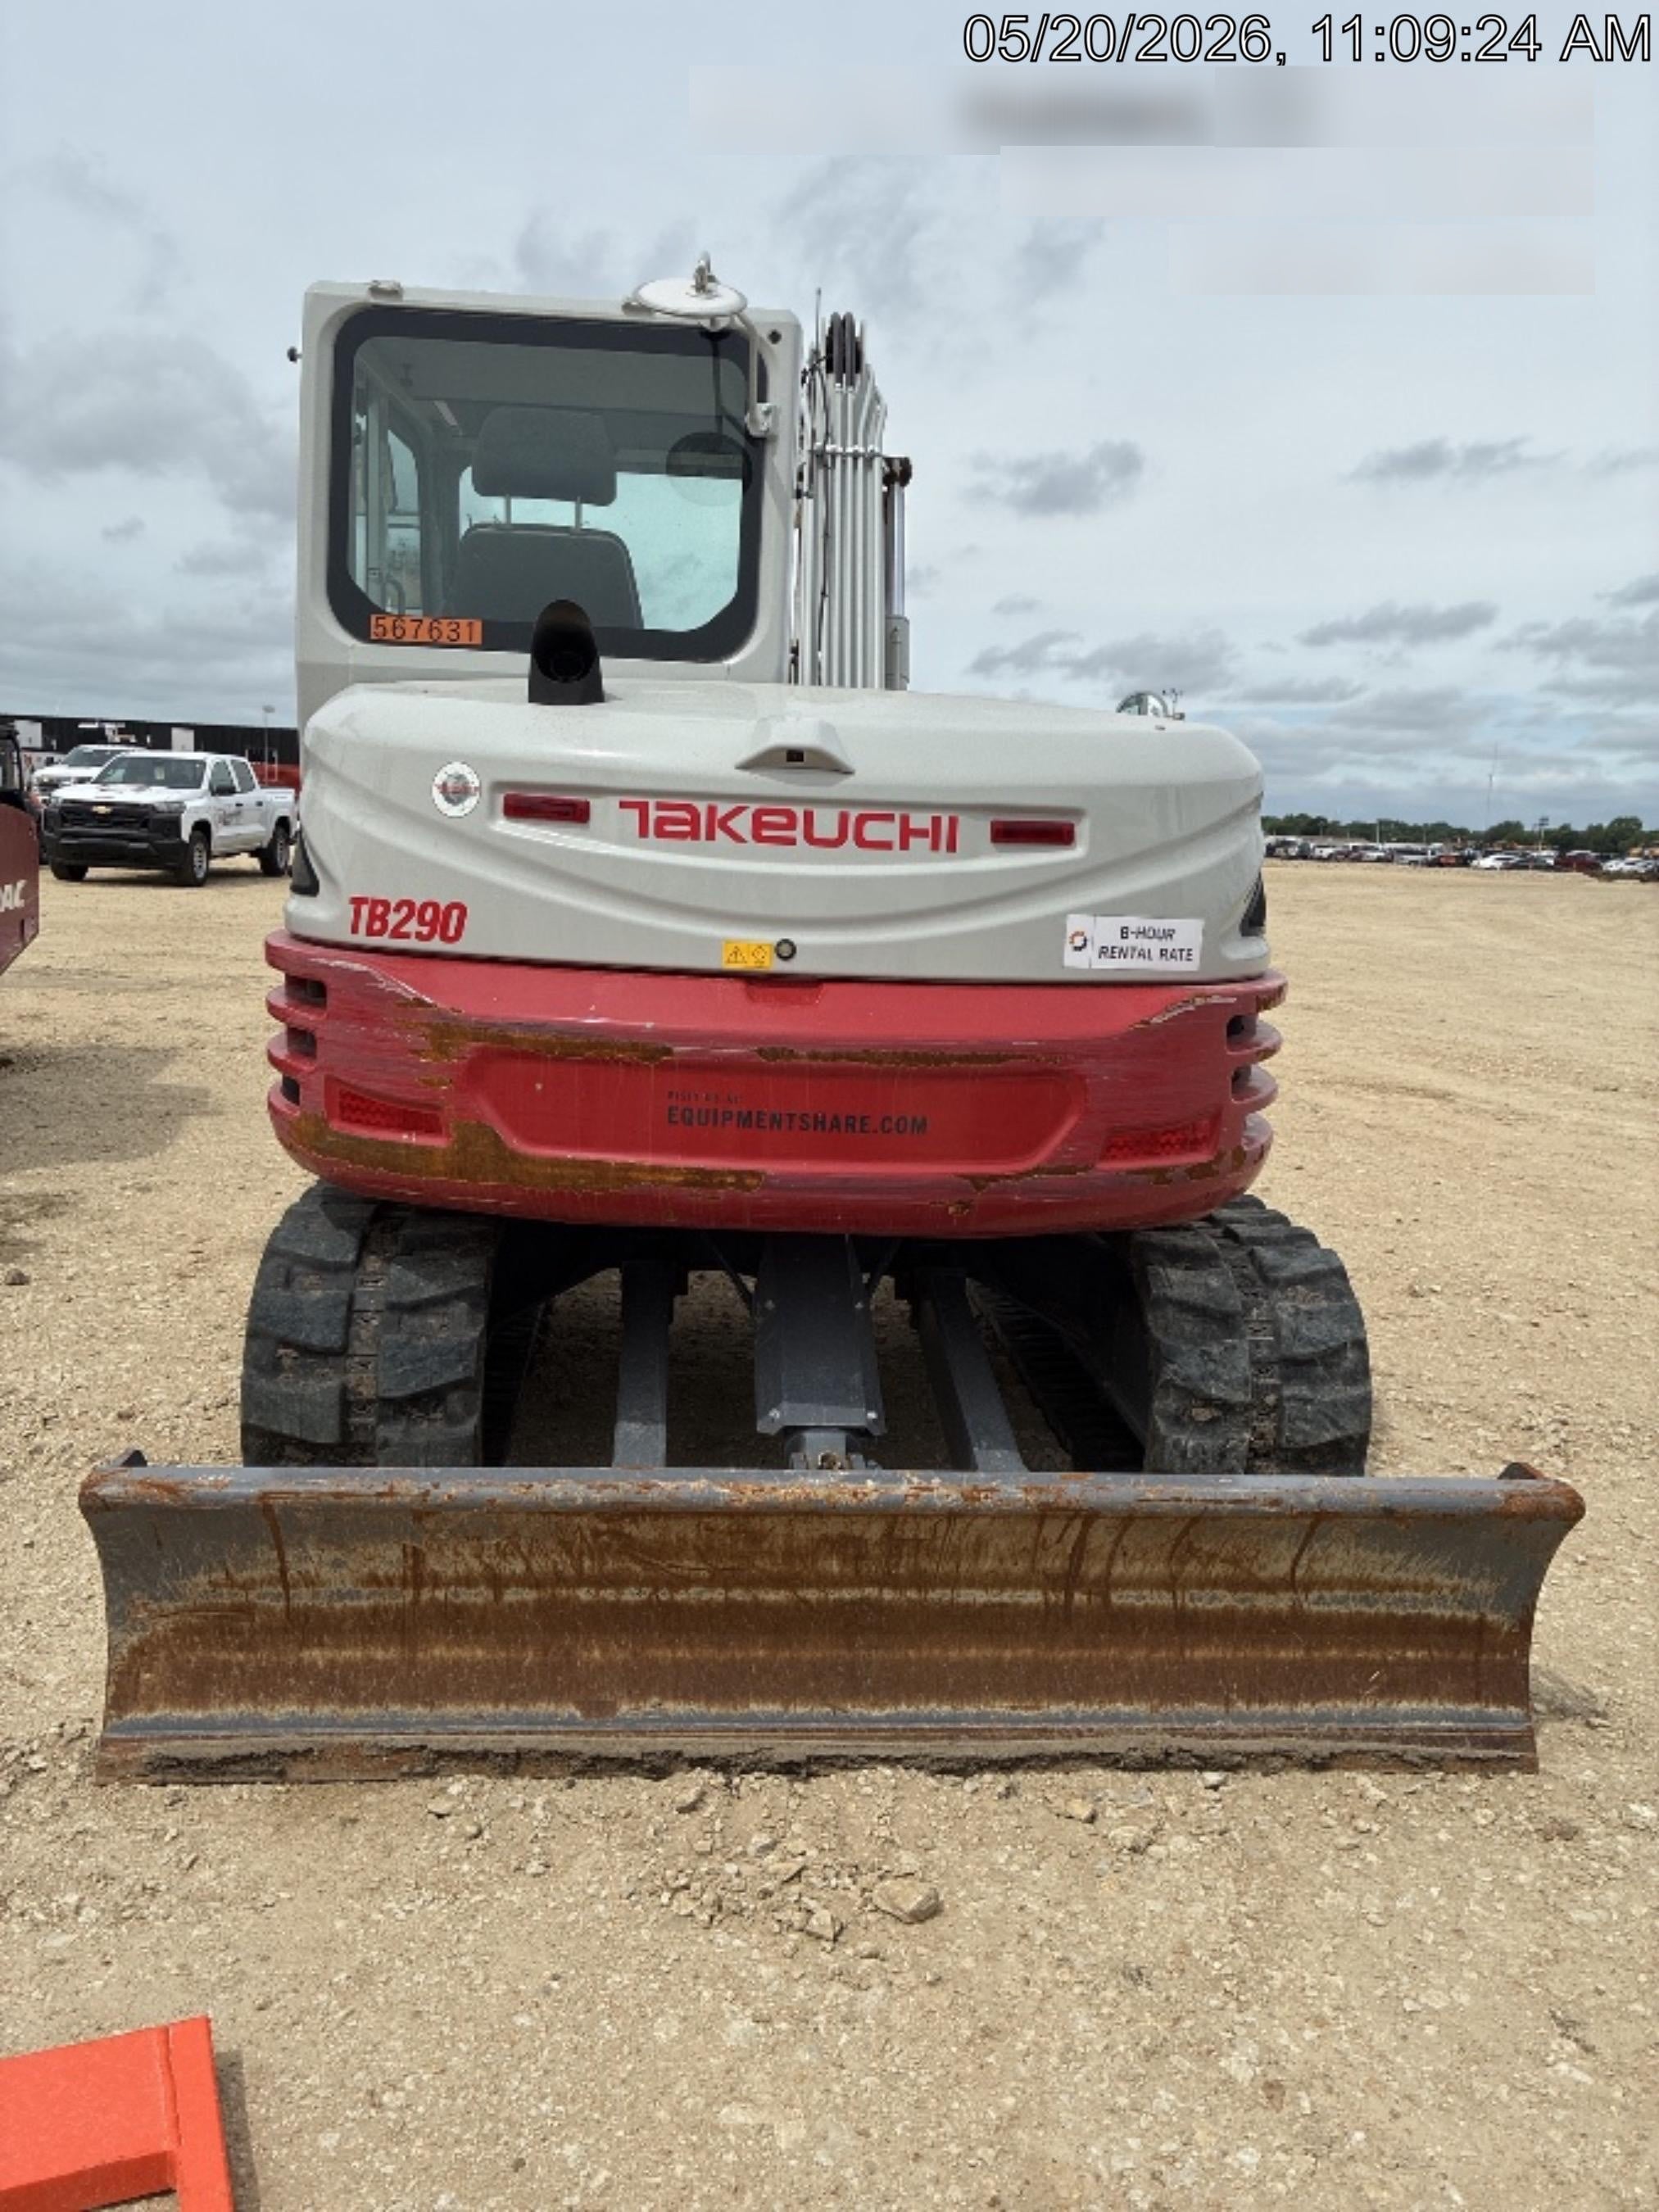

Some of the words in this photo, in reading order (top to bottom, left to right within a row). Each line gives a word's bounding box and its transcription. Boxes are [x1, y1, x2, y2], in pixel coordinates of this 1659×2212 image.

[373, 616, 475, 642] 567631
[0, 879, 27, 913] AC
[349, 895, 468, 944] TB290
[1098, 945, 1154, 961] RENTAL
[1159, 948, 1193, 962] RATE
[668, 1106, 927, 1135] EQUIPMENTSHARE.COM
